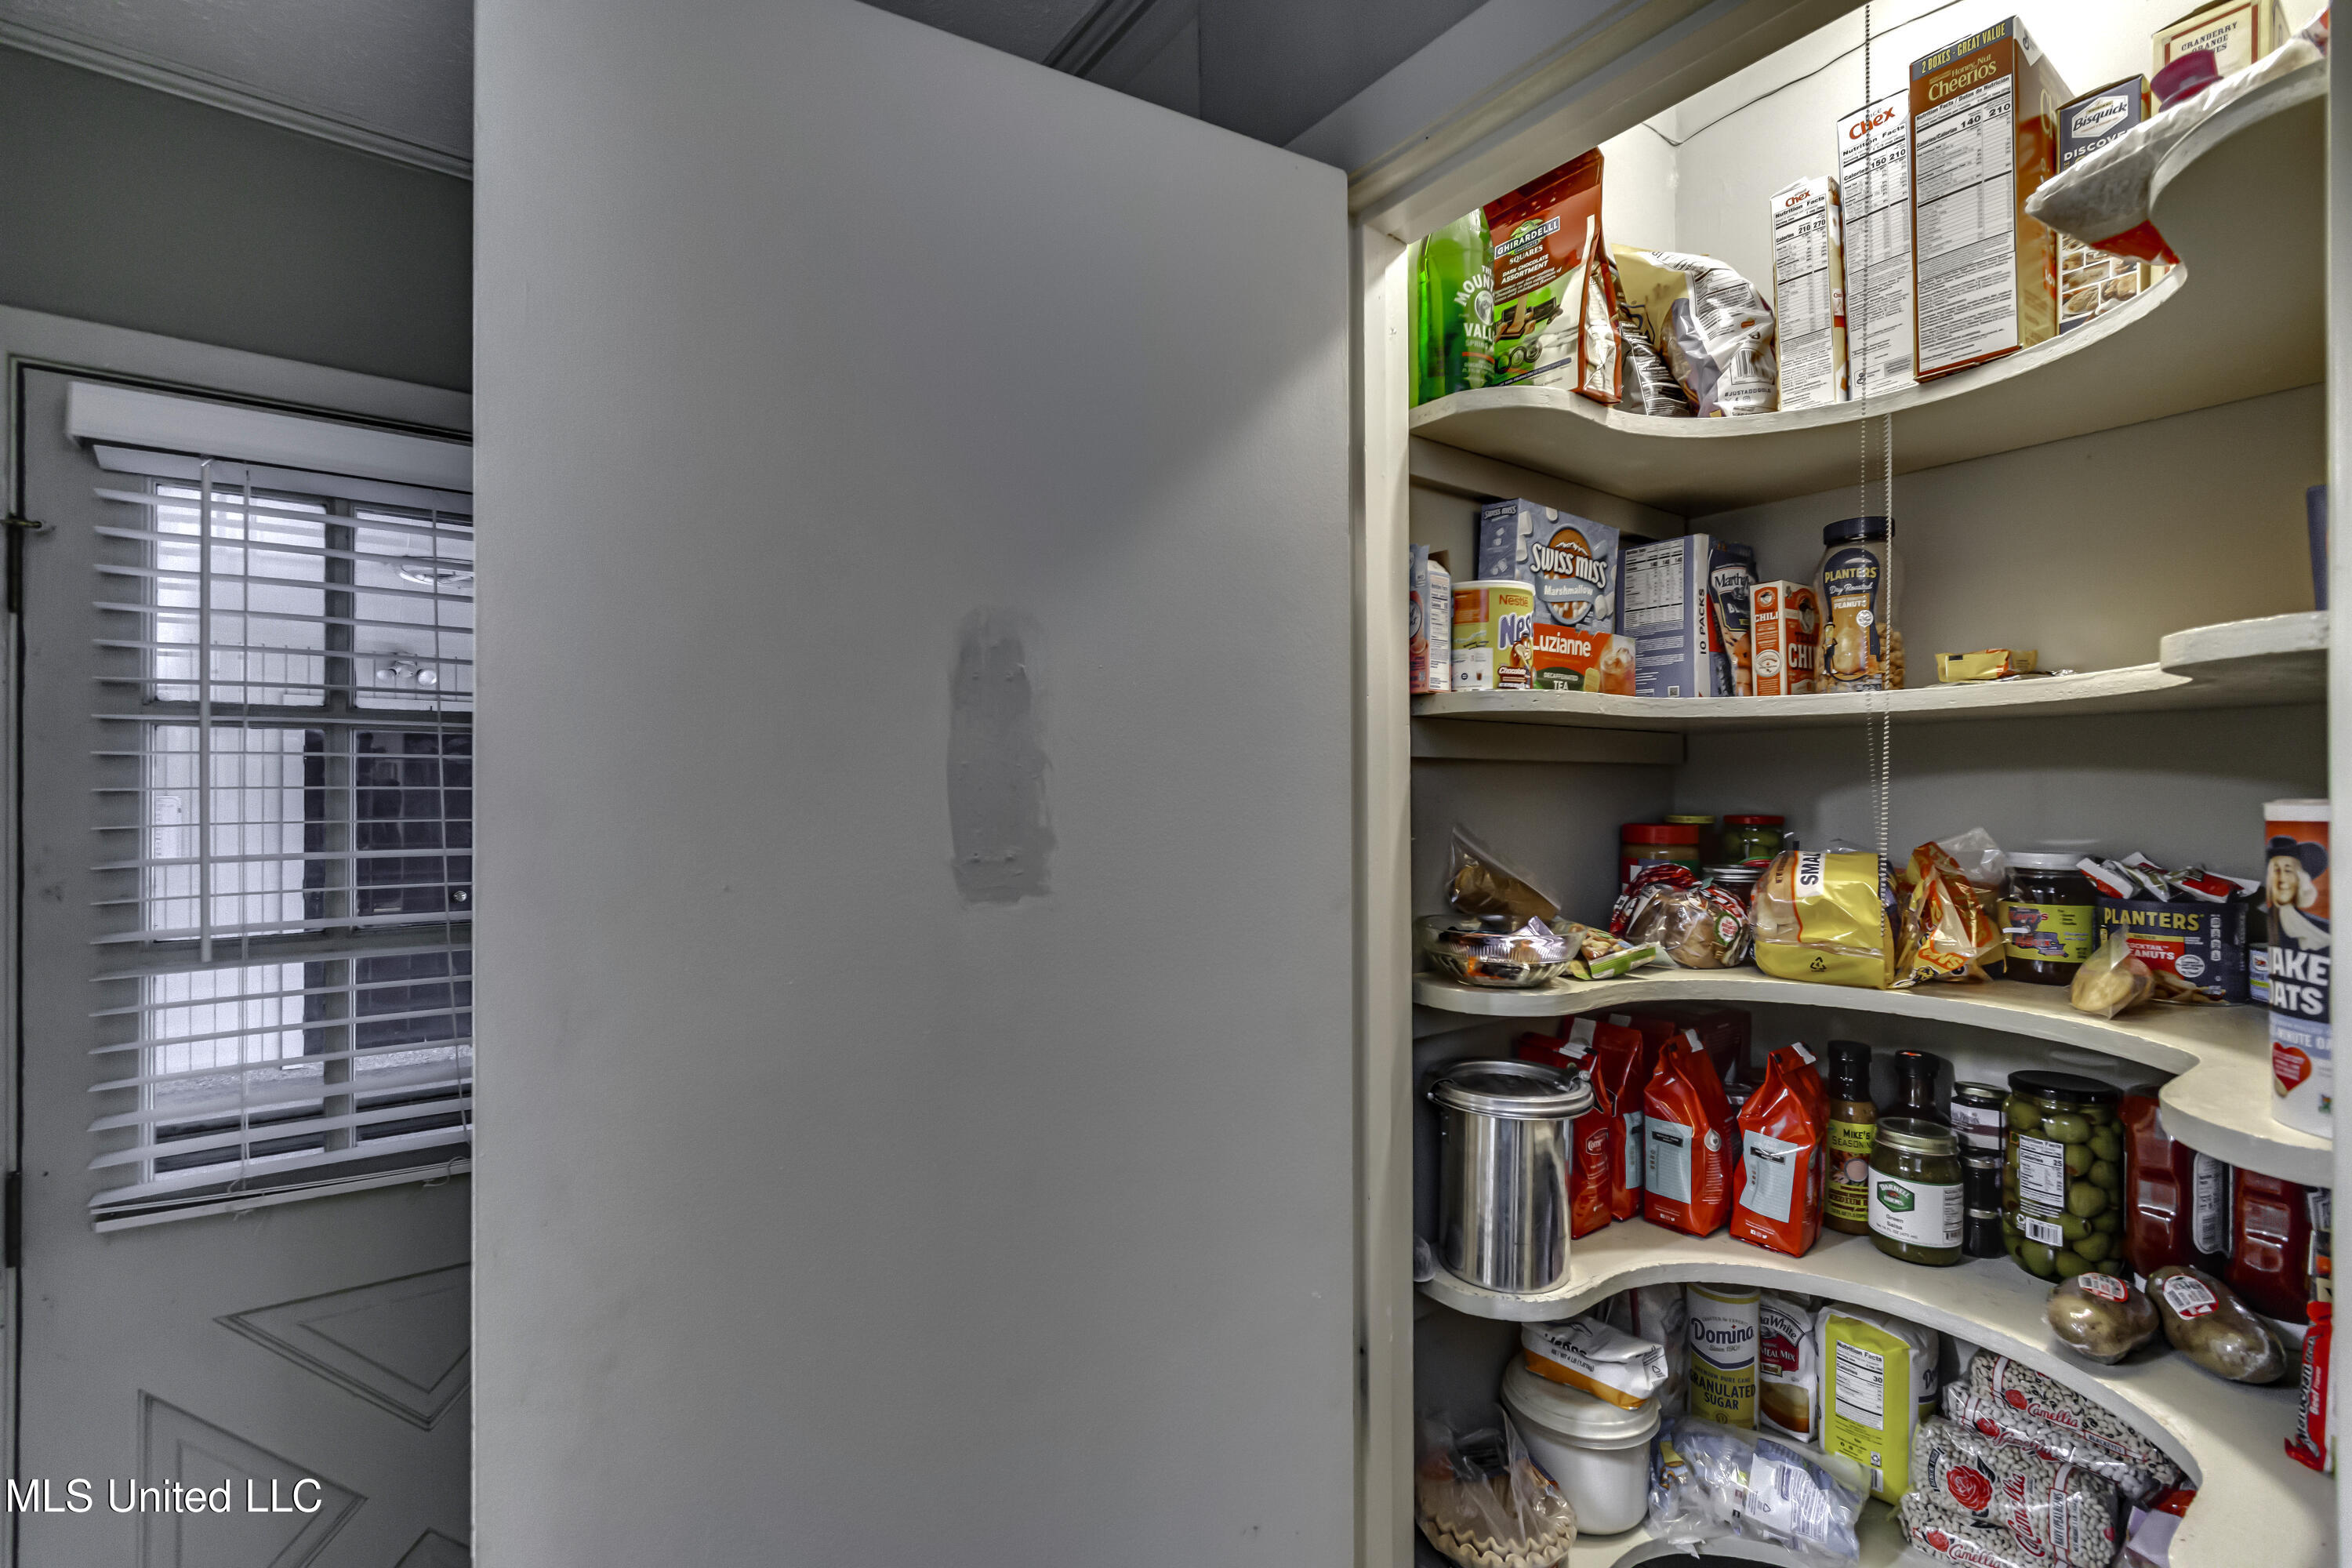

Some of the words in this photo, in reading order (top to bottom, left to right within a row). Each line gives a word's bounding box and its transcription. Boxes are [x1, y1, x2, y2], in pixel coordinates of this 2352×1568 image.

[2181, 21, 2238, 52] CRANBERRY
[1922, 61, 1927, 74] 2
[1928, 49, 1951, 71] BOXES
[1957, 34, 1981, 56] GREAT
[1982, 23, 2006, 45] VALUE
[1928, 60, 1997, 101] Cheerios
[1951, 62, 1976, 77] Honey
[1849, 106, 1896, 140] Chex
[1960, 114, 1981, 129] 140
[1988, 103, 2011, 118] 210
[2073, 102, 2128, 132] Bisquick
[1882, 125, 1905, 139] Facts
[1871, 157, 1887, 169] 150
[1889, 148, 1906, 162] 210
[1775, 205, 1803, 219] Nutrition
[1806, 196, 1825, 206] Facts
[1785, 190, 1811, 208] Chex
[1798, 224, 1811, 234] 210
[1813, 219, 1826, 229] 270
[1502, 267, 1518, 278] DARK
[1518, 253, 1549, 270] CHOCOLATE
[1508, 245, 1544, 265] SQUARES
[1501, 260, 1549, 285] ASSORTMENT
[1824, 567, 1878, 584] PLANTERS
[1544, 584, 1594, 597] Marshmallow
[1697, 588, 1708, 636] PACKS
[1754, 611, 1780, 623] CHILI
[1553, 680, 1570, 691] TEA
[2103, 907, 2200, 931] PLANTERS
[2129, 949, 2176, 960] EANUTS
[2053, 1159, 2063, 1167] 25
[1690, 1317, 1754, 1345] Domino
[1836, 1341, 1863, 1356] Nutrition
[1864, 1351, 1882, 1363] Facts
[1872, 1375, 1883, 1384] 30
[1704, 1392, 1740, 1410] SUGAR
[2027, 1403, 2079, 1428] Camellia
[2002, 1472, 2046, 1558] Camellia
